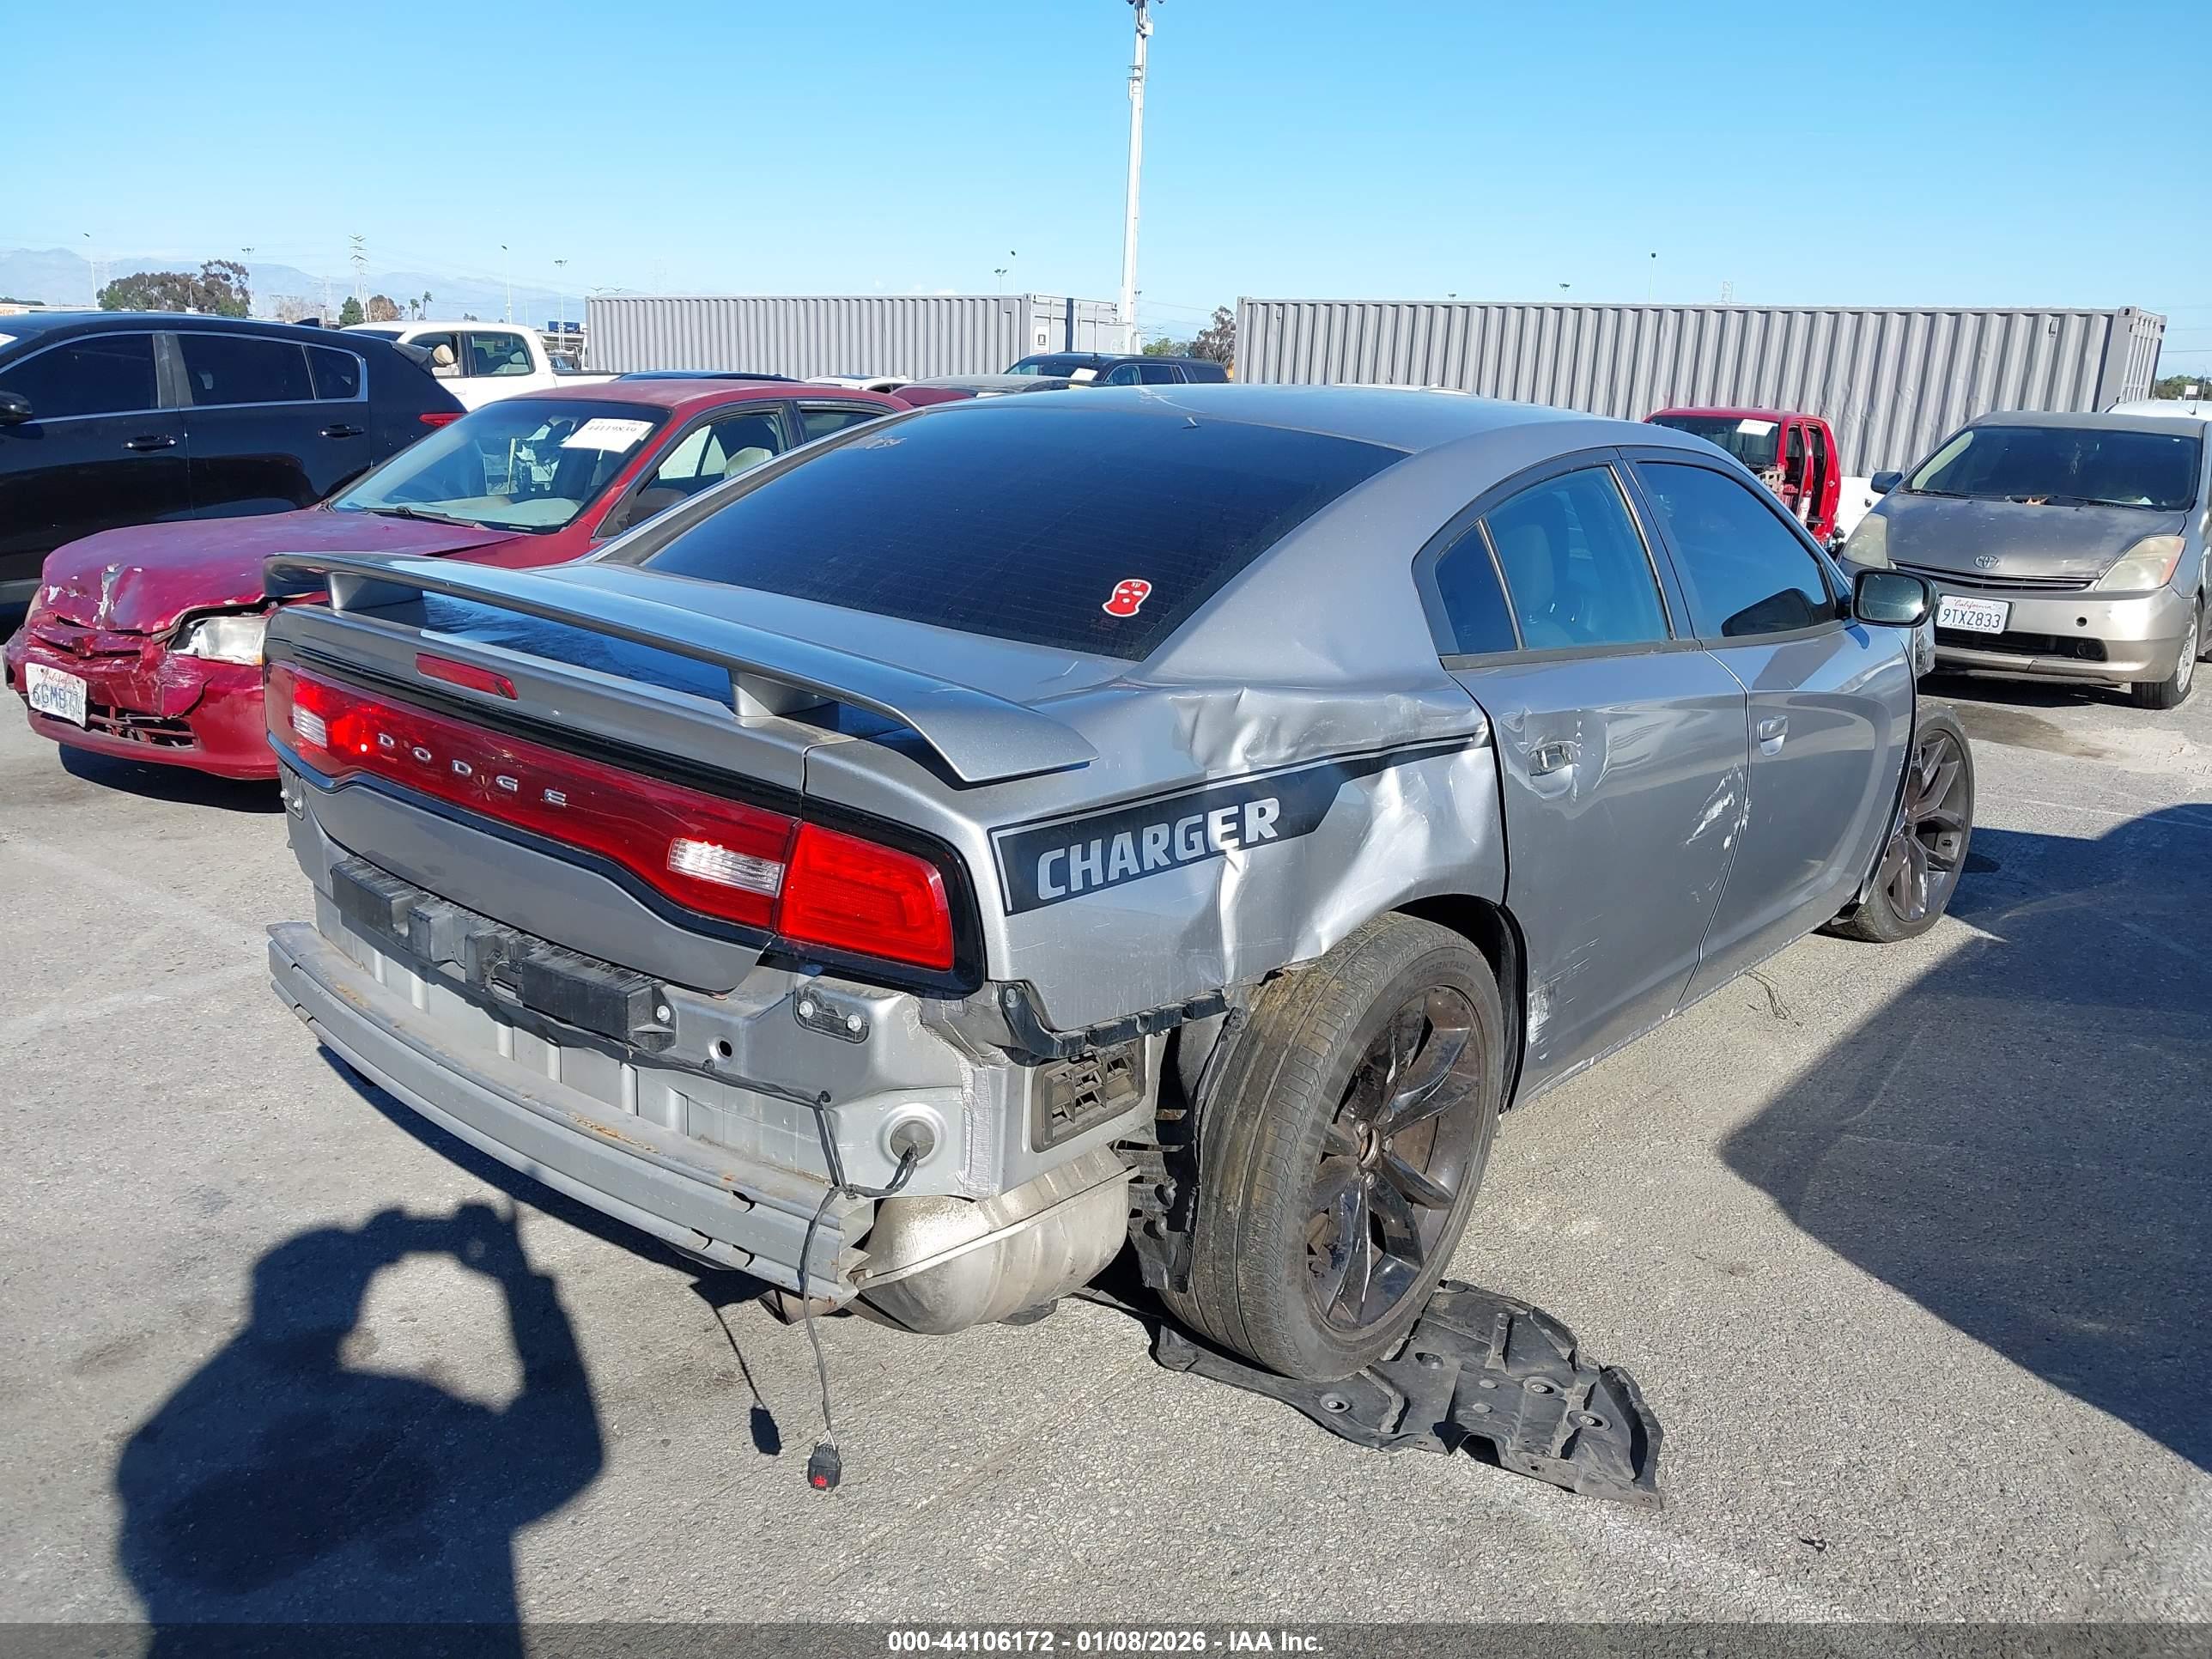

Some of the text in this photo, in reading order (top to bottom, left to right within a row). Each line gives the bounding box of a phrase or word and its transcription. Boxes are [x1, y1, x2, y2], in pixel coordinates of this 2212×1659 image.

[1942, 608, 2002, 629] 9TXZ833
[1954, 599, 1991, 610] California
[378, 732, 567, 808] DODGE
[1037, 797, 1280, 901] CHARGER
